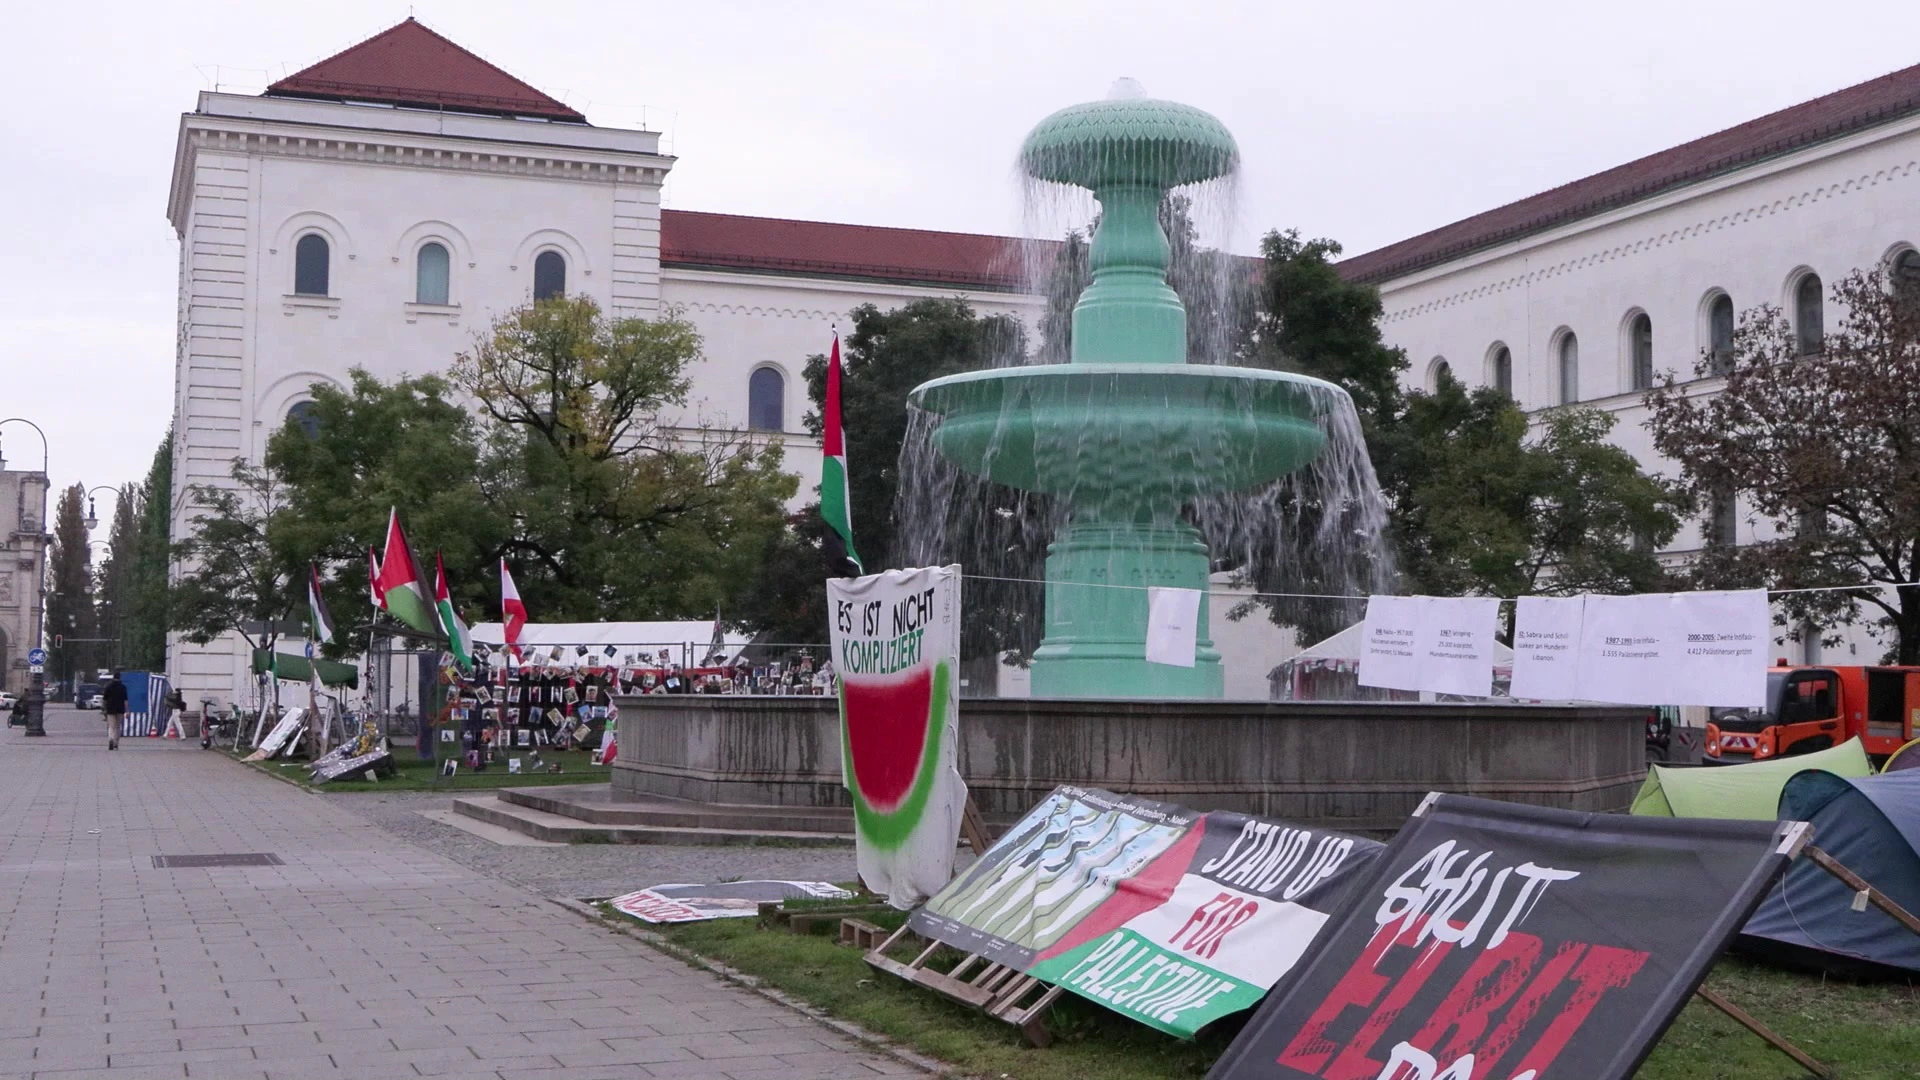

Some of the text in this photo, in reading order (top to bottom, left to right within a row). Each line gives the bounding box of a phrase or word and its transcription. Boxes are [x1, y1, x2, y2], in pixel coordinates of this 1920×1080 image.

[838, 600, 853, 634] ES
[863, 600, 881, 637] IST
[893, 587, 935, 638] NICHT
[1526, 631, 1542, 639] Sabra
[1543, 631, 1555, 639] und
[842, 628, 924, 674] KOMPLIZIERT
[1602, 649, 1618, 658] 1.555
[1201, 820, 1354, 900] STAND UP
[1168, 892, 1259, 959] FOR
[1370, 839, 1581, 953] SHUT
[1061, 931, 1237, 1024] PALESTINE
[1276, 913, 1651, 1080] ELBIT
